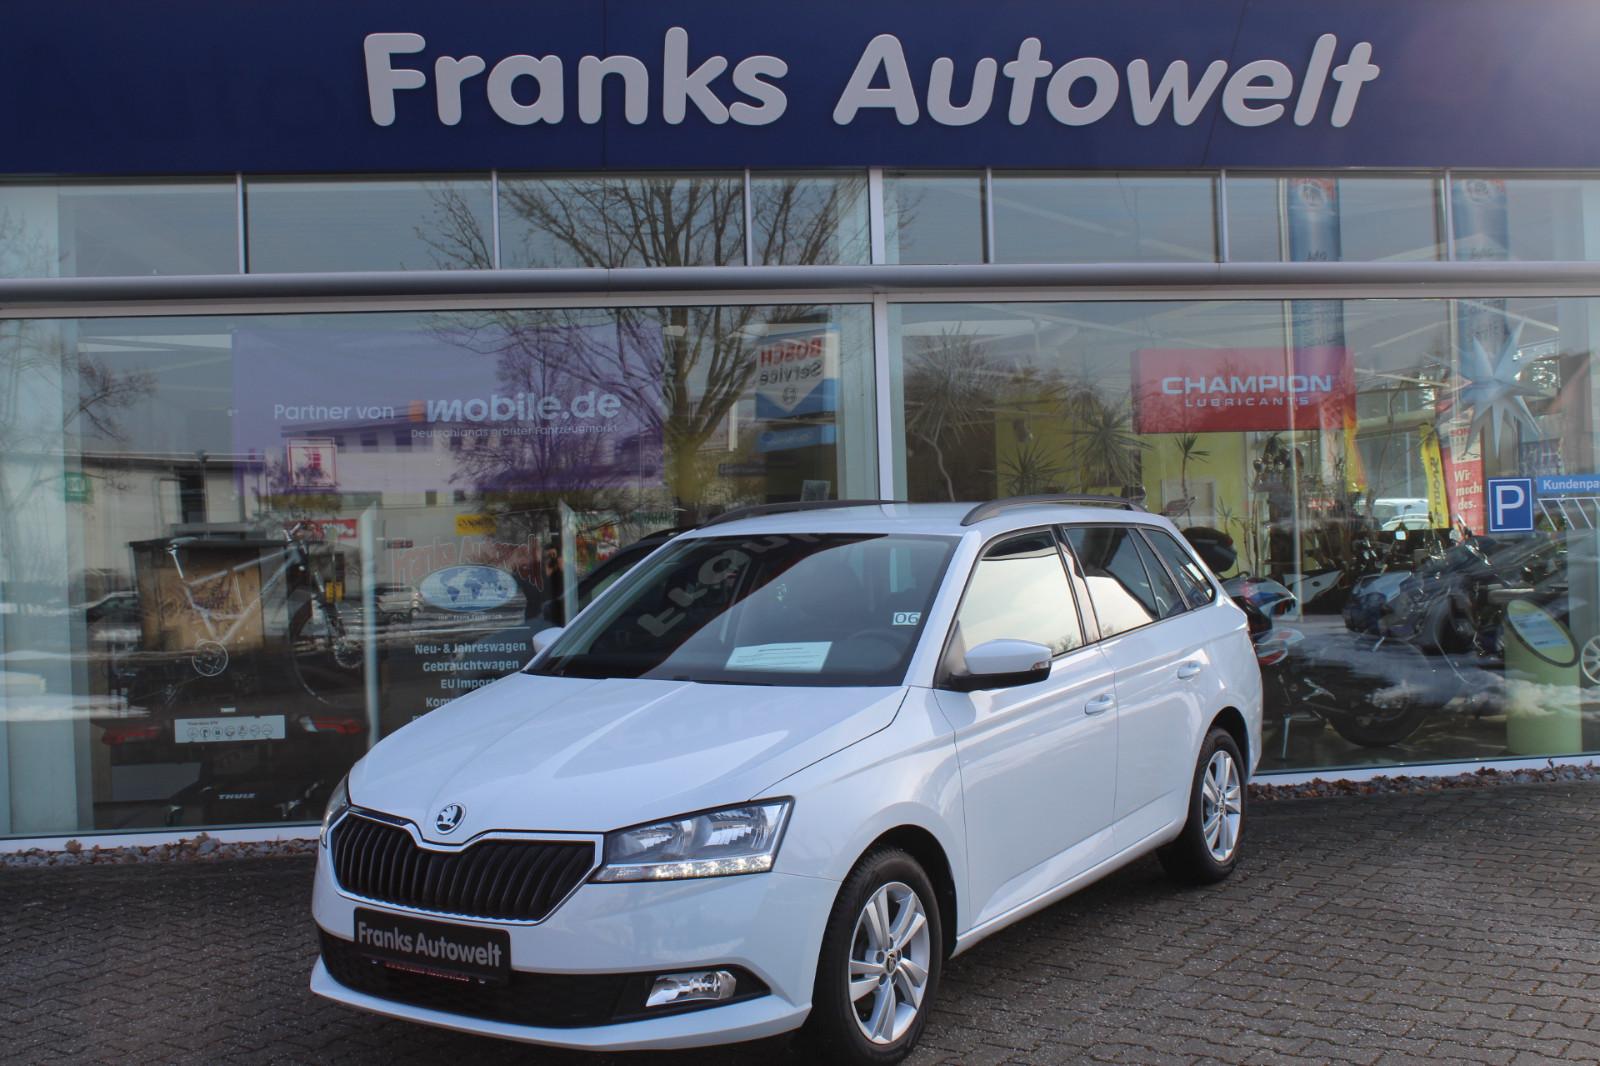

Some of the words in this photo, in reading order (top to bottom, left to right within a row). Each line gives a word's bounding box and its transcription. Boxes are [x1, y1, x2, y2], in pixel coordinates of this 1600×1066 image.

[363, 27, 789, 126] Franks
[832, 33, 1380, 128] Autowelt
[1162, 375, 1333, 395] CHAMPION
[274, 403, 351, 421] Partner
[356, 406, 395, 420] von
[426, 391, 622, 422] mobile.de
[1185, 397, 1309, 408] LUBRICANTS
[1454, 469, 1472, 482] Wir
[1495, 484, 1525, 526] P
[415, 643, 441, 655] Neu-
[443, 643, 451, 654] &
[452, 641, 527, 654] Jahreswagen
[423, 660, 520, 672] Gebrauchtwagen
[440, 679, 455, 689] EU
[218, 792, 257, 800] THULE
[358, 921, 413, 953] Franks
[415, 932, 503, 967] Autowelt
